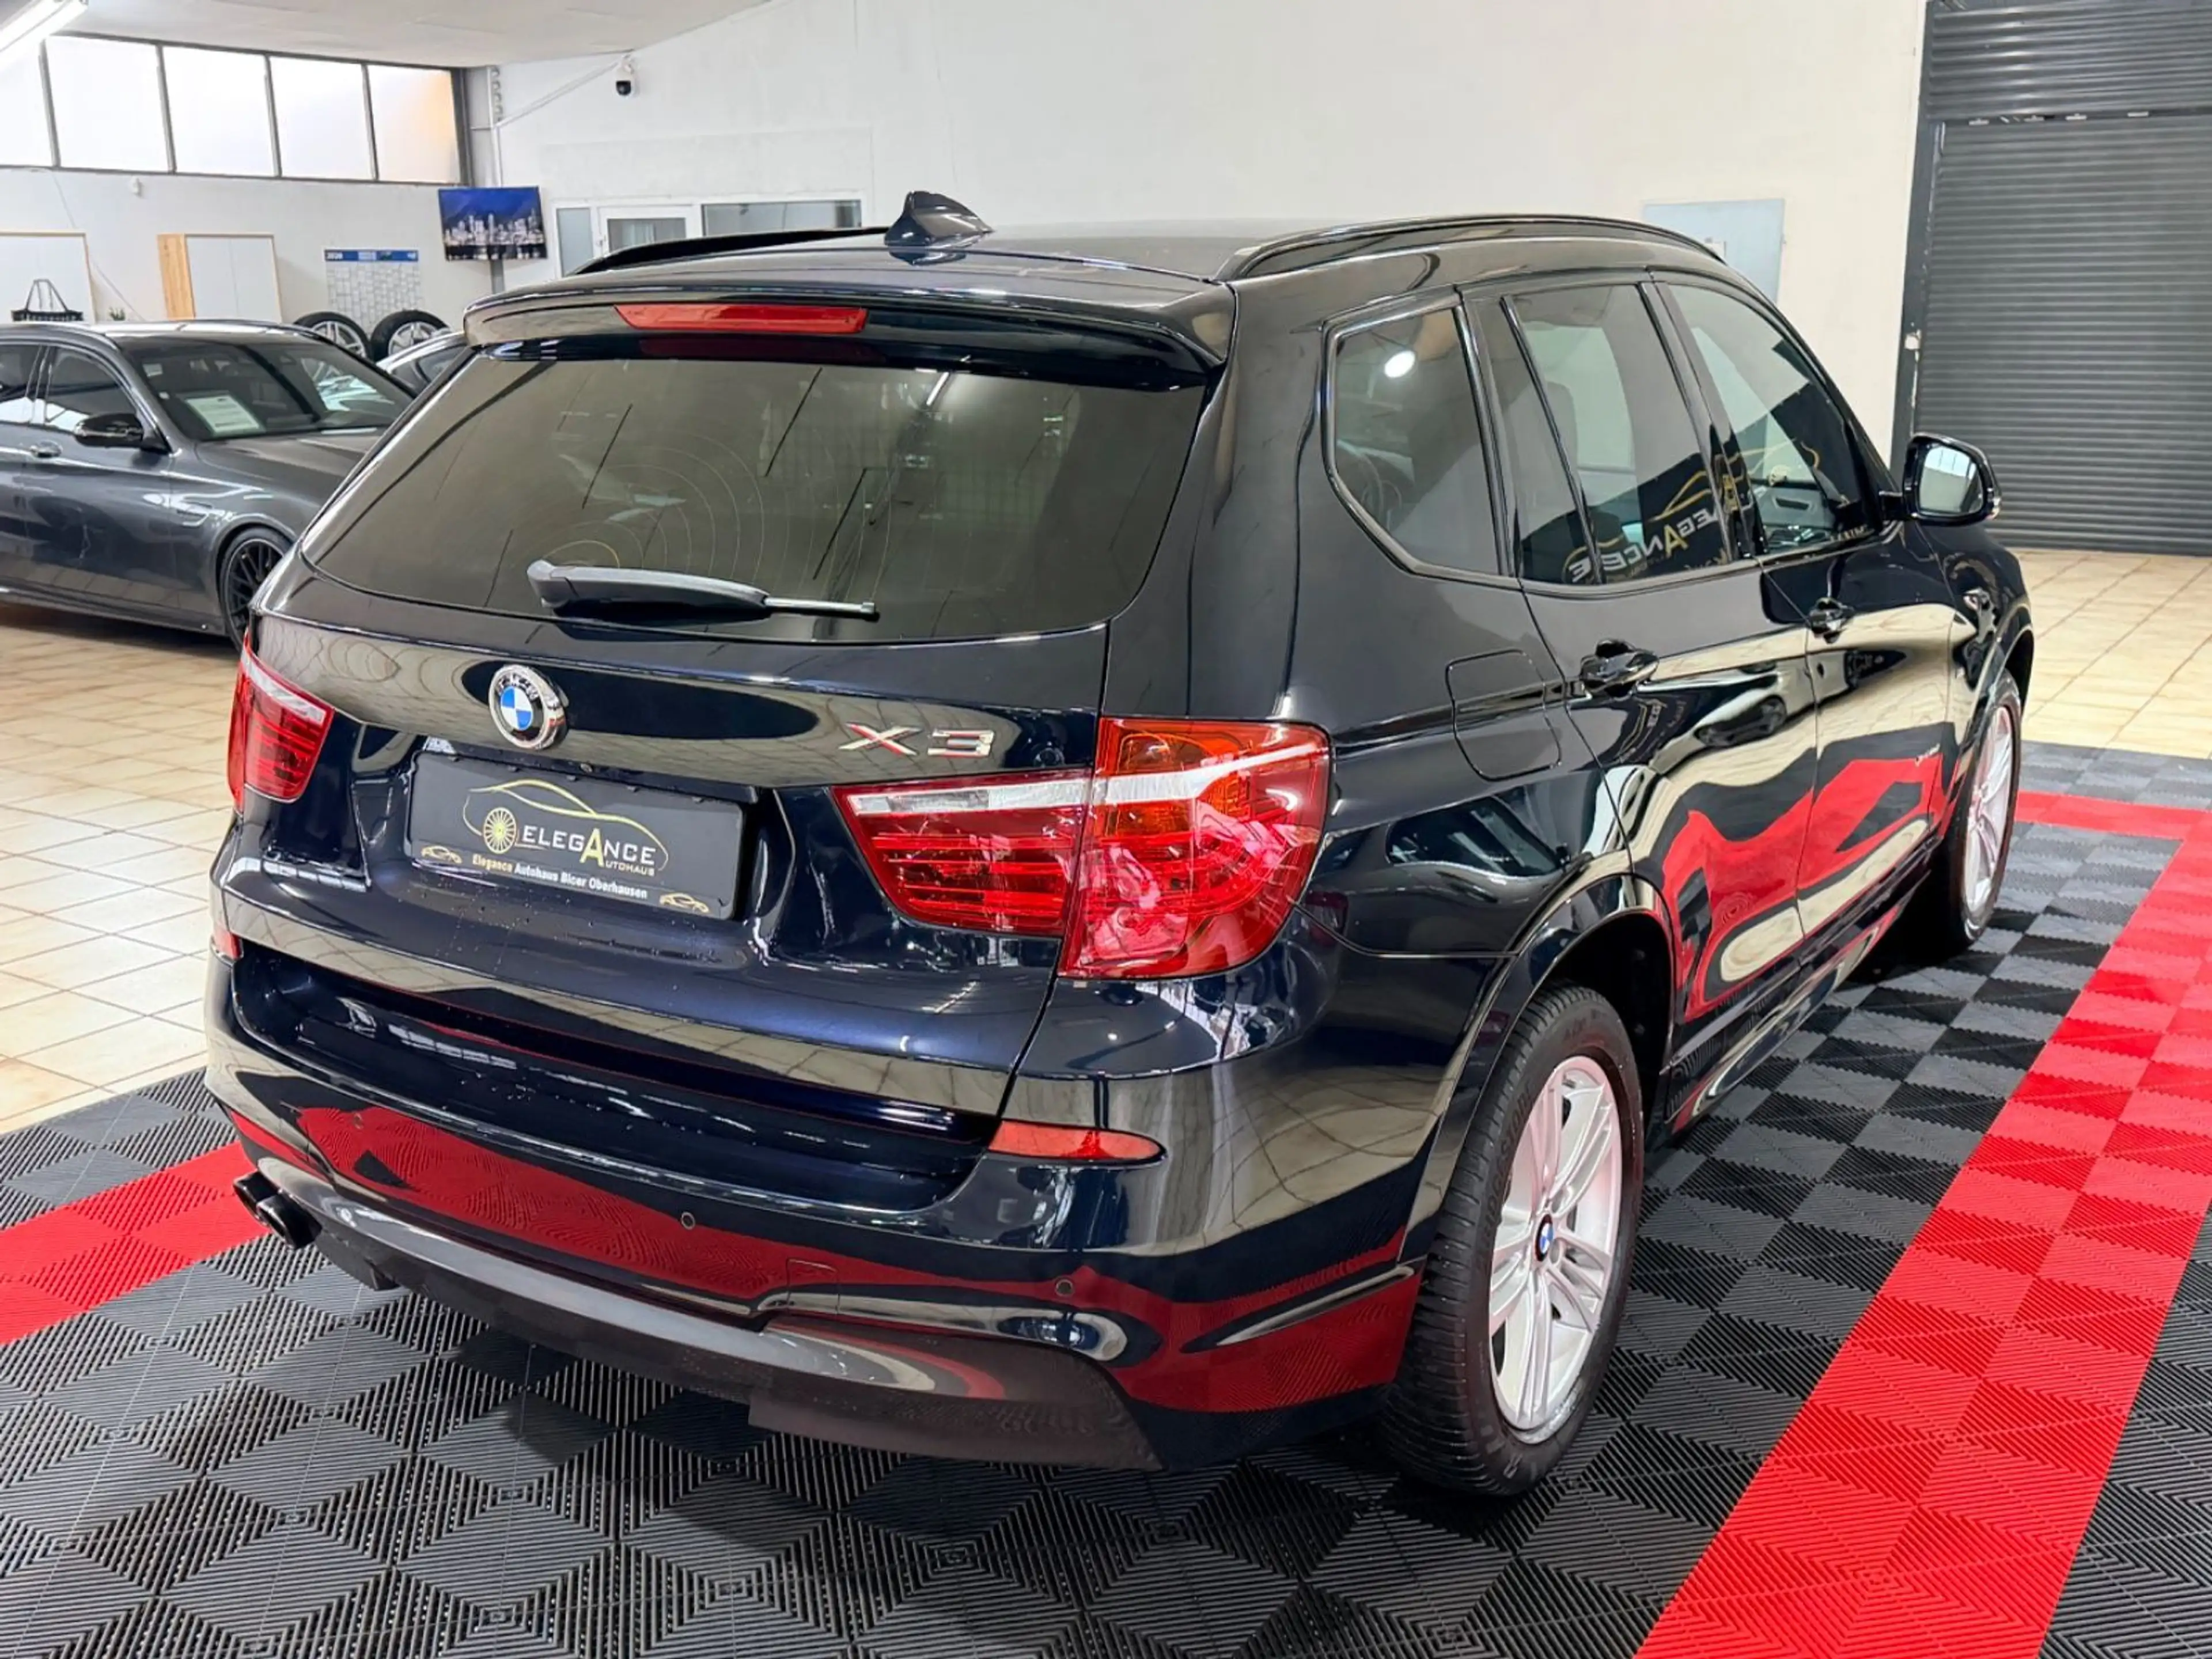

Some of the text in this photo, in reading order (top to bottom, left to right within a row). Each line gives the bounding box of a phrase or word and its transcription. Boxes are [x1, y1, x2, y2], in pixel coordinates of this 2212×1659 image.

[837, 721, 994, 759] X3
[522, 824, 656, 867] ELEGANCE
[472, 853, 513, 872] Elegance
[514, 862, 559, 881] Autohaus
[588, 877, 648, 899] Oberhausen
